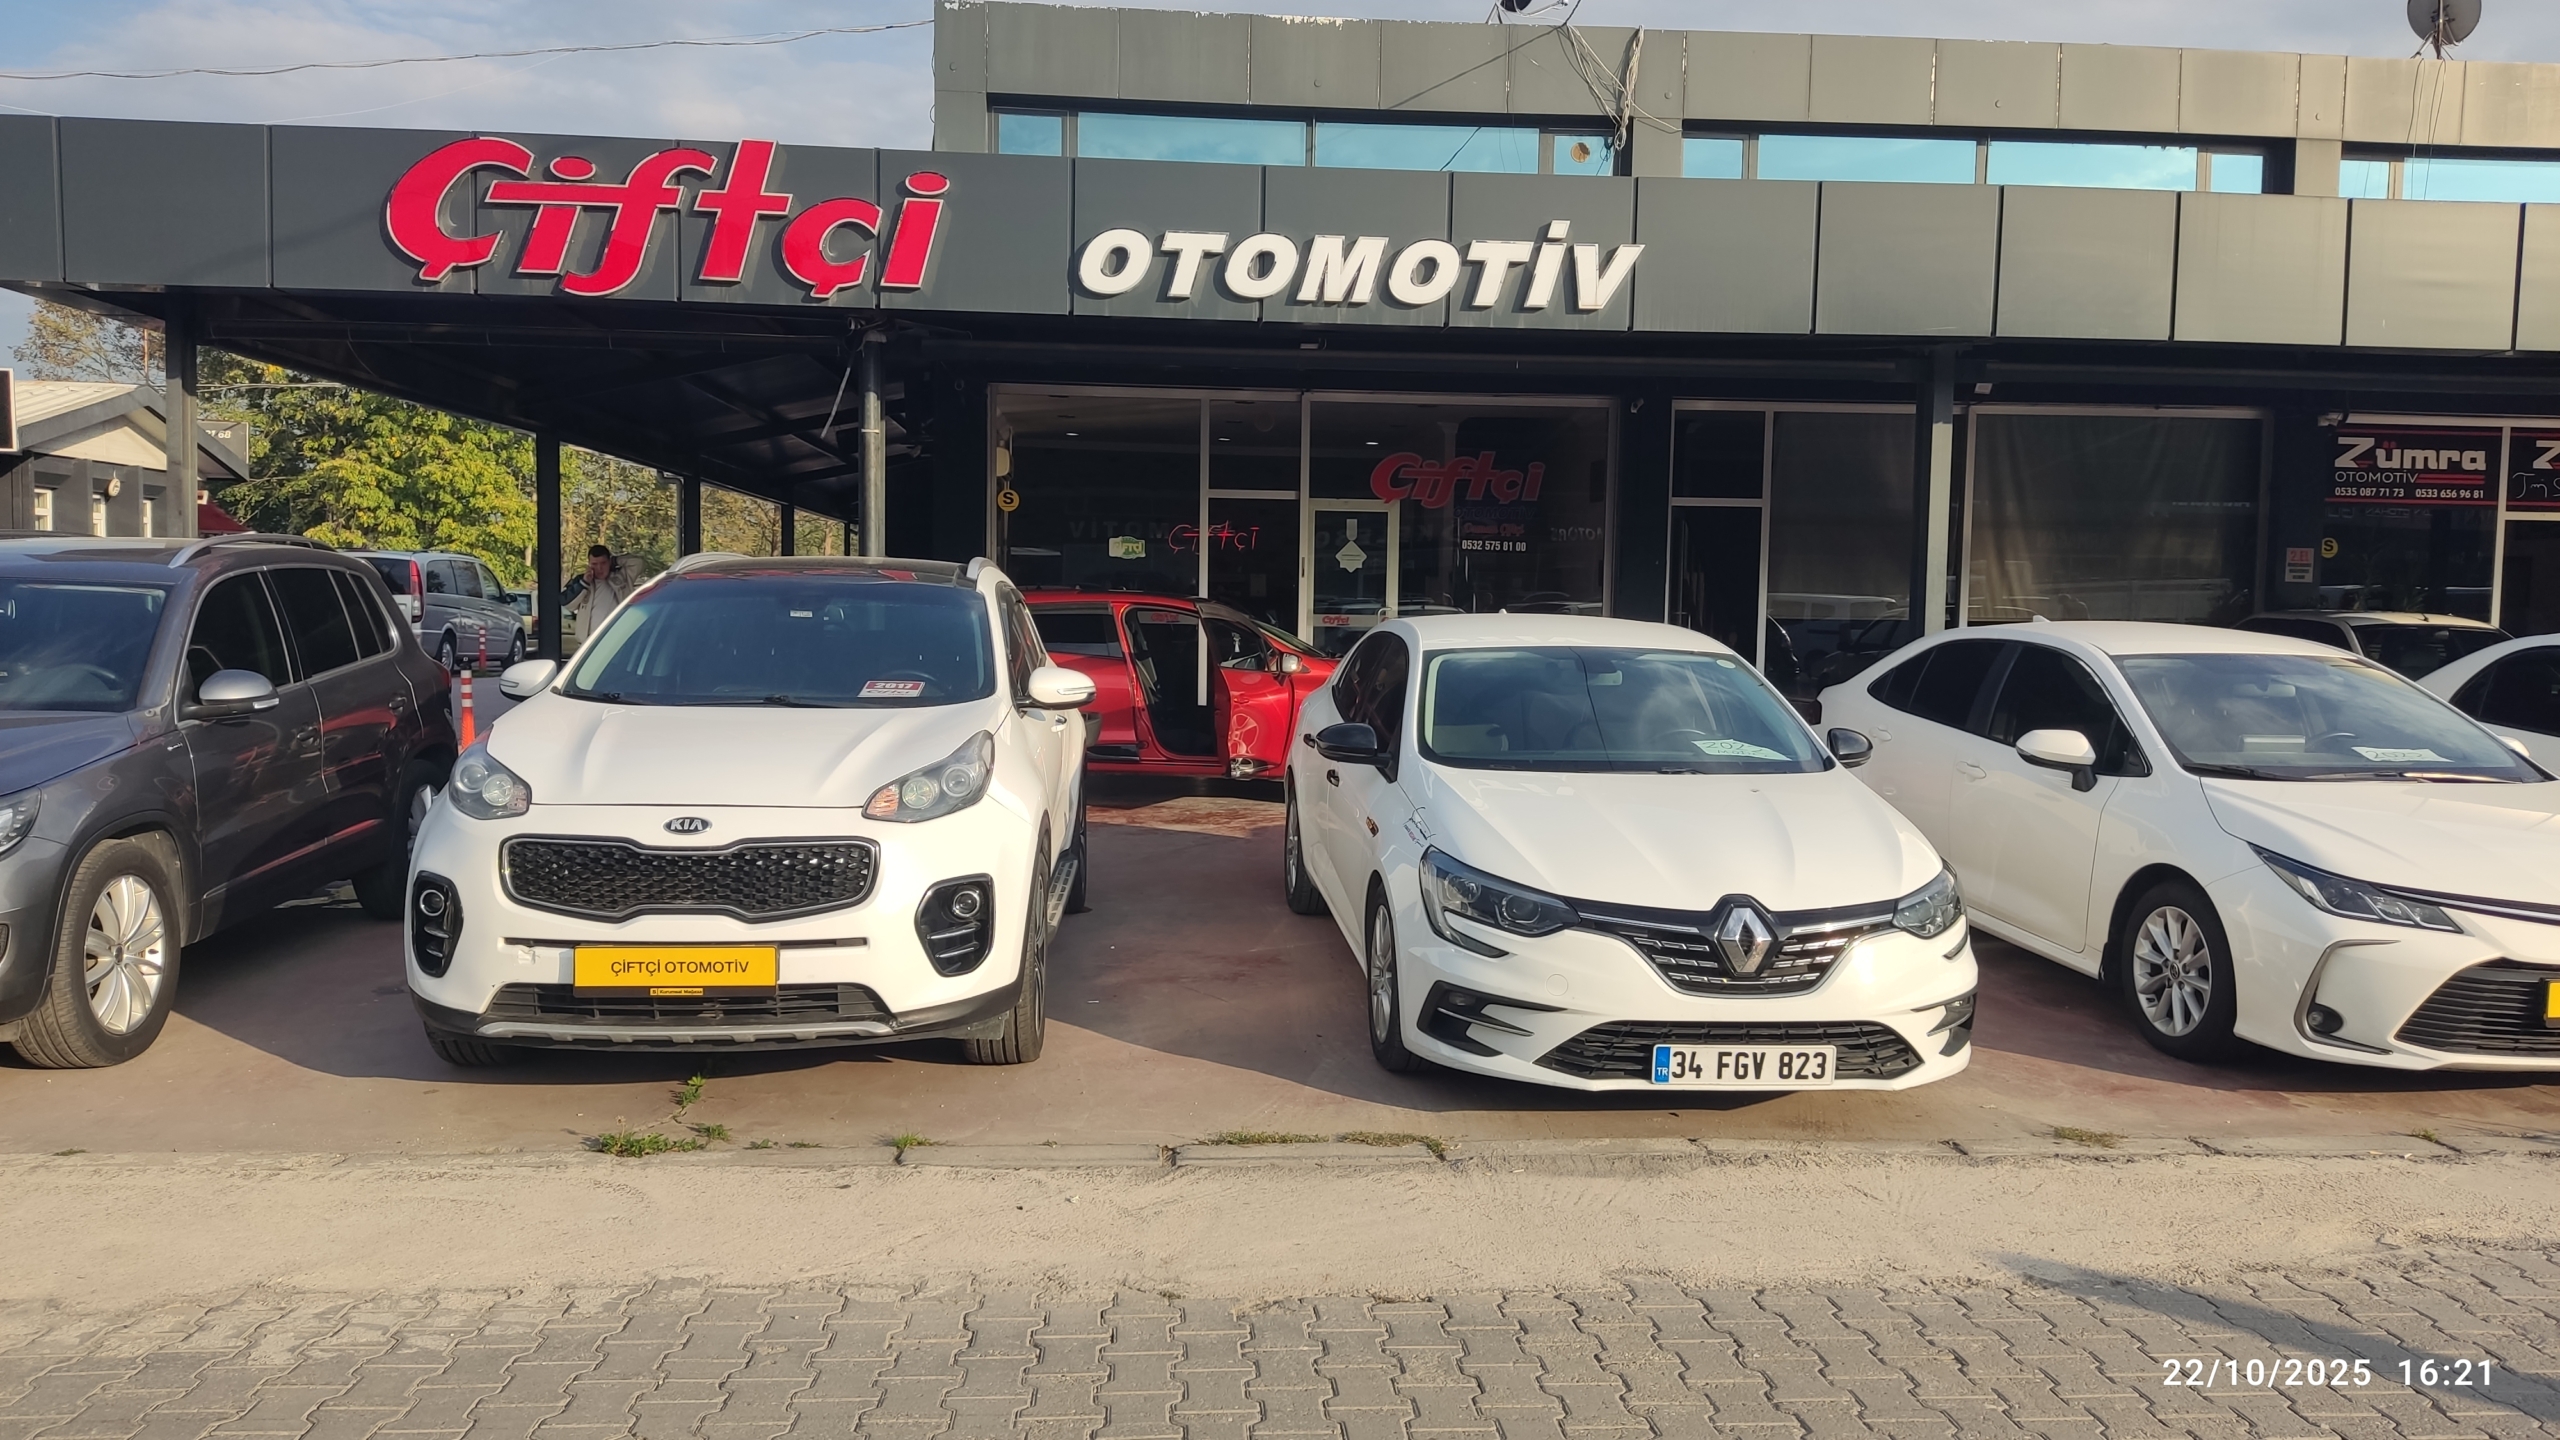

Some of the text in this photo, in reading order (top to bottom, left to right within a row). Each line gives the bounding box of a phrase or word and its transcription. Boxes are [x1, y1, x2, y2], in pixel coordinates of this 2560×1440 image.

[385, 136, 951, 298] Çiftçi
[1078, 219, 1645, 310] OTOMOTİV
[217, 430, 232, 439] 68
[2334, 436, 2487, 471] Zümra
[1370, 450, 1546, 510] Çiftçi
[2334, 469, 2419, 484] OTOMOTİV
[1002, 491, 1015, 505] S
[2334, 487, 2484, 499] 0535 087 71 73 0533 656 96 81
[1461, 539, 1527, 552] 0532 575 81 00
[2323, 538, 2334, 552] S
[670, 818, 703, 831] KIA
[610, 958, 749, 977] ÇİFTÇİ OTOMOTİV
[1656, 1051, 1828, 1080] TR 34 FGV 823
